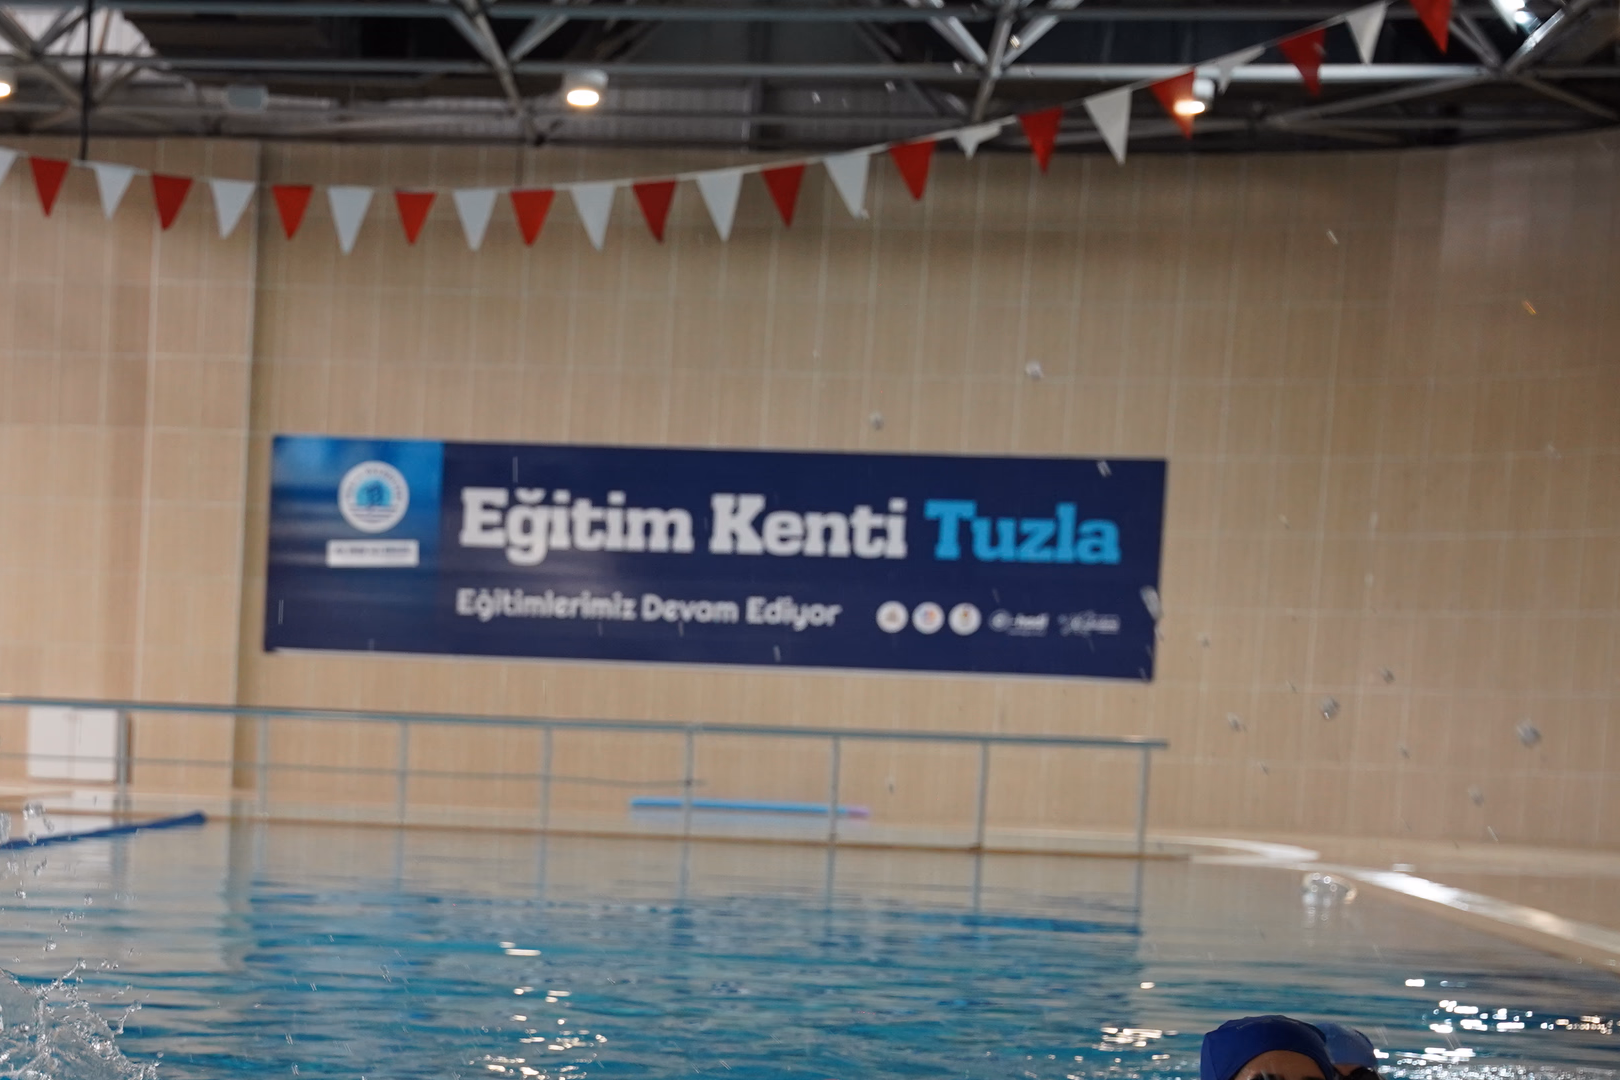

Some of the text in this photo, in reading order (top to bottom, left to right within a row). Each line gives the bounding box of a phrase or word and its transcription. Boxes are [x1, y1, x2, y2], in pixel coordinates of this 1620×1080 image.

[459, 487, 1121, 566] Eğitim Kenti Tuzla
[456, 588, 842, 632] Eğitimlerimiz Devam Ediyor
